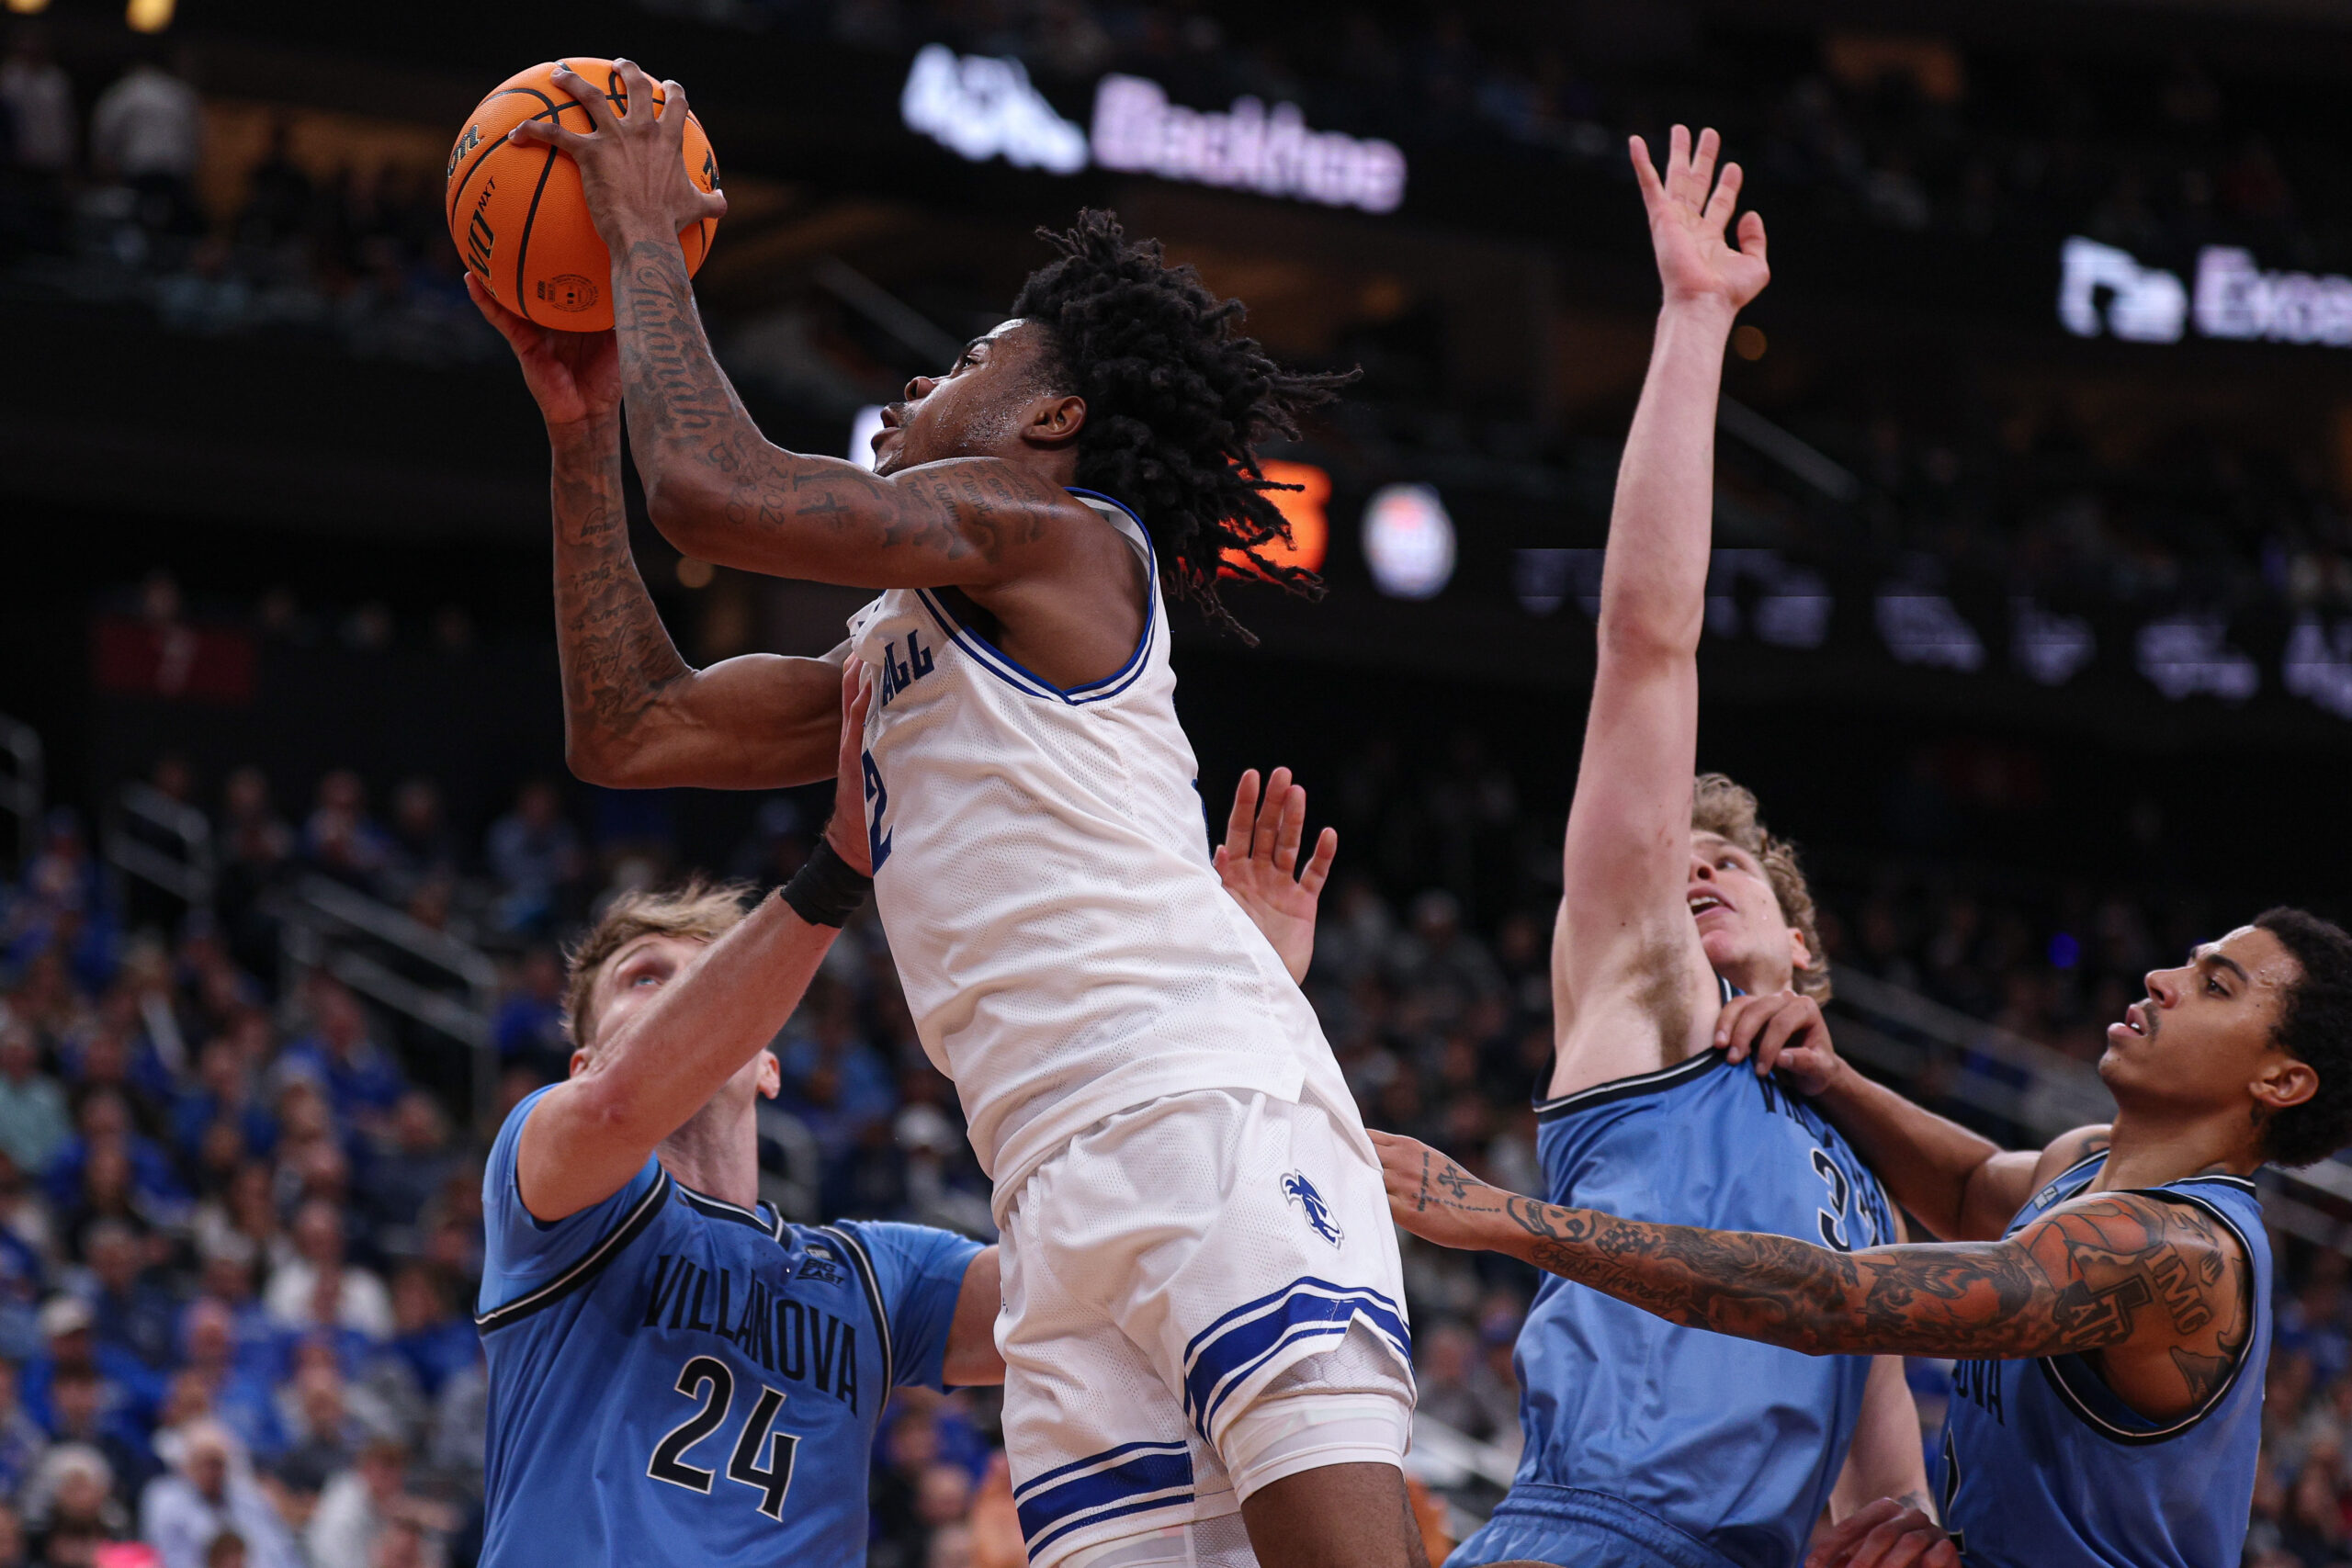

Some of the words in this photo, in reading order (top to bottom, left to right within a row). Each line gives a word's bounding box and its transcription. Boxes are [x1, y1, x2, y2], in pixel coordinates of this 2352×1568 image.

[478, 175, 497, 212] NXT
[467, 209, 498, 298] VO
[805, 1258, 837, 1274] BIG
[643, 1253, 858, 1419] VILLANOVA
[647, 1355, 802, 1523] 24
